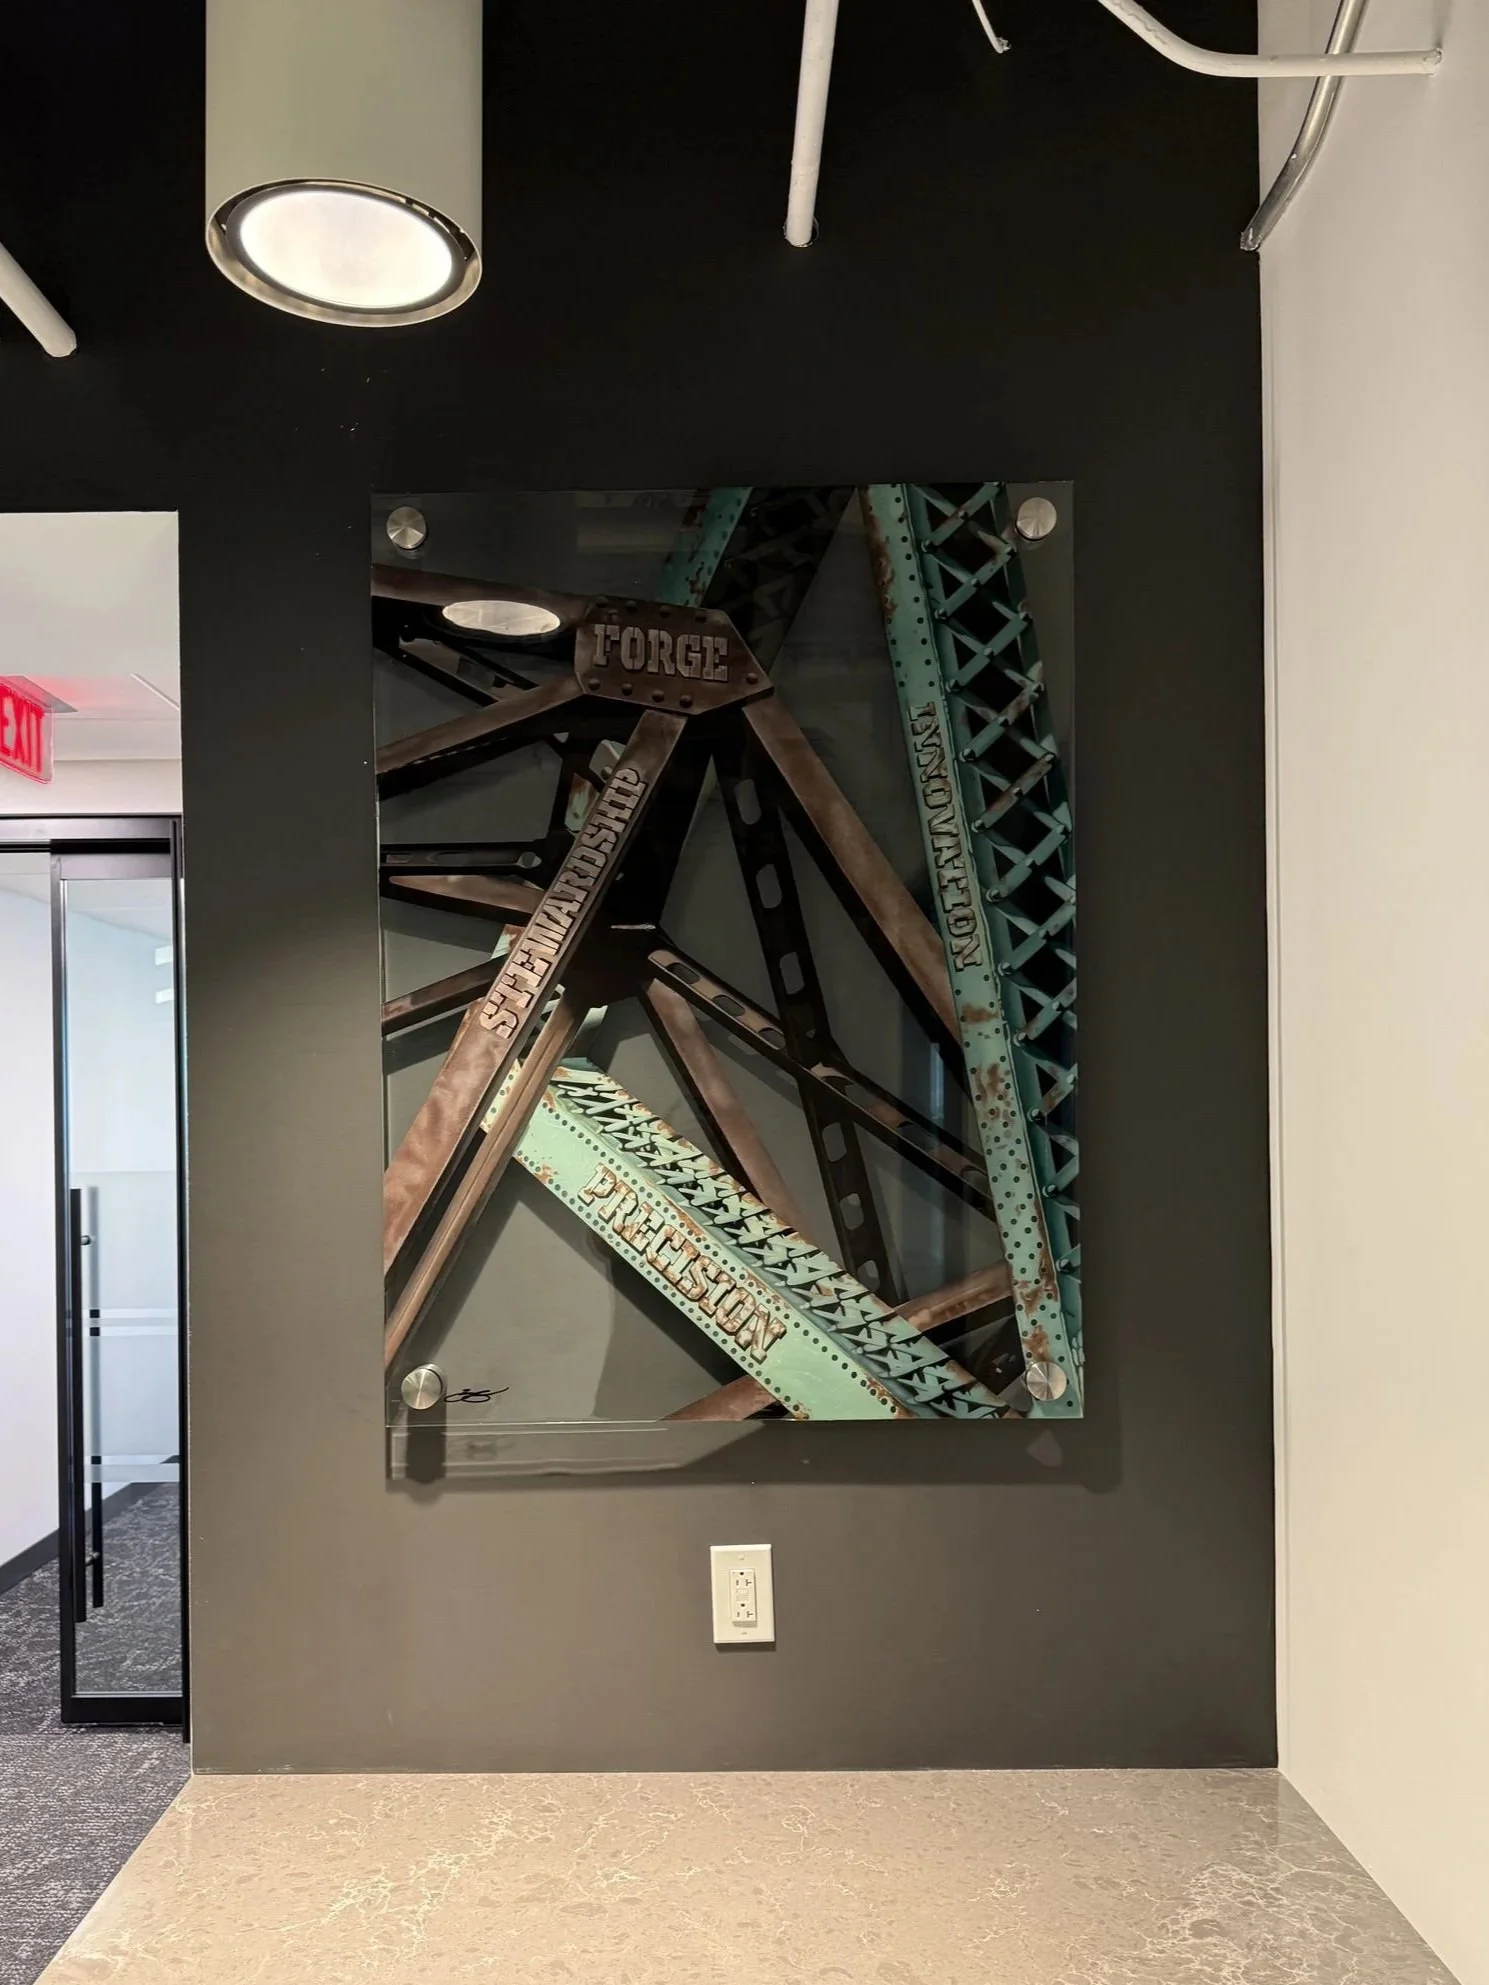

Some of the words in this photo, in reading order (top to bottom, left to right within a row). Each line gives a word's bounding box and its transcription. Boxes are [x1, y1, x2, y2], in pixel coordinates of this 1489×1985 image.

[0, 684, 45, 772] EXIT
[593, 624, 728, 682] FORGE
[479, 767, 648, 1039] STEWARDSHIP
[908, 702, 982, 971] INNOVATION
[577, 1163, 787, 1364] PRECISION
